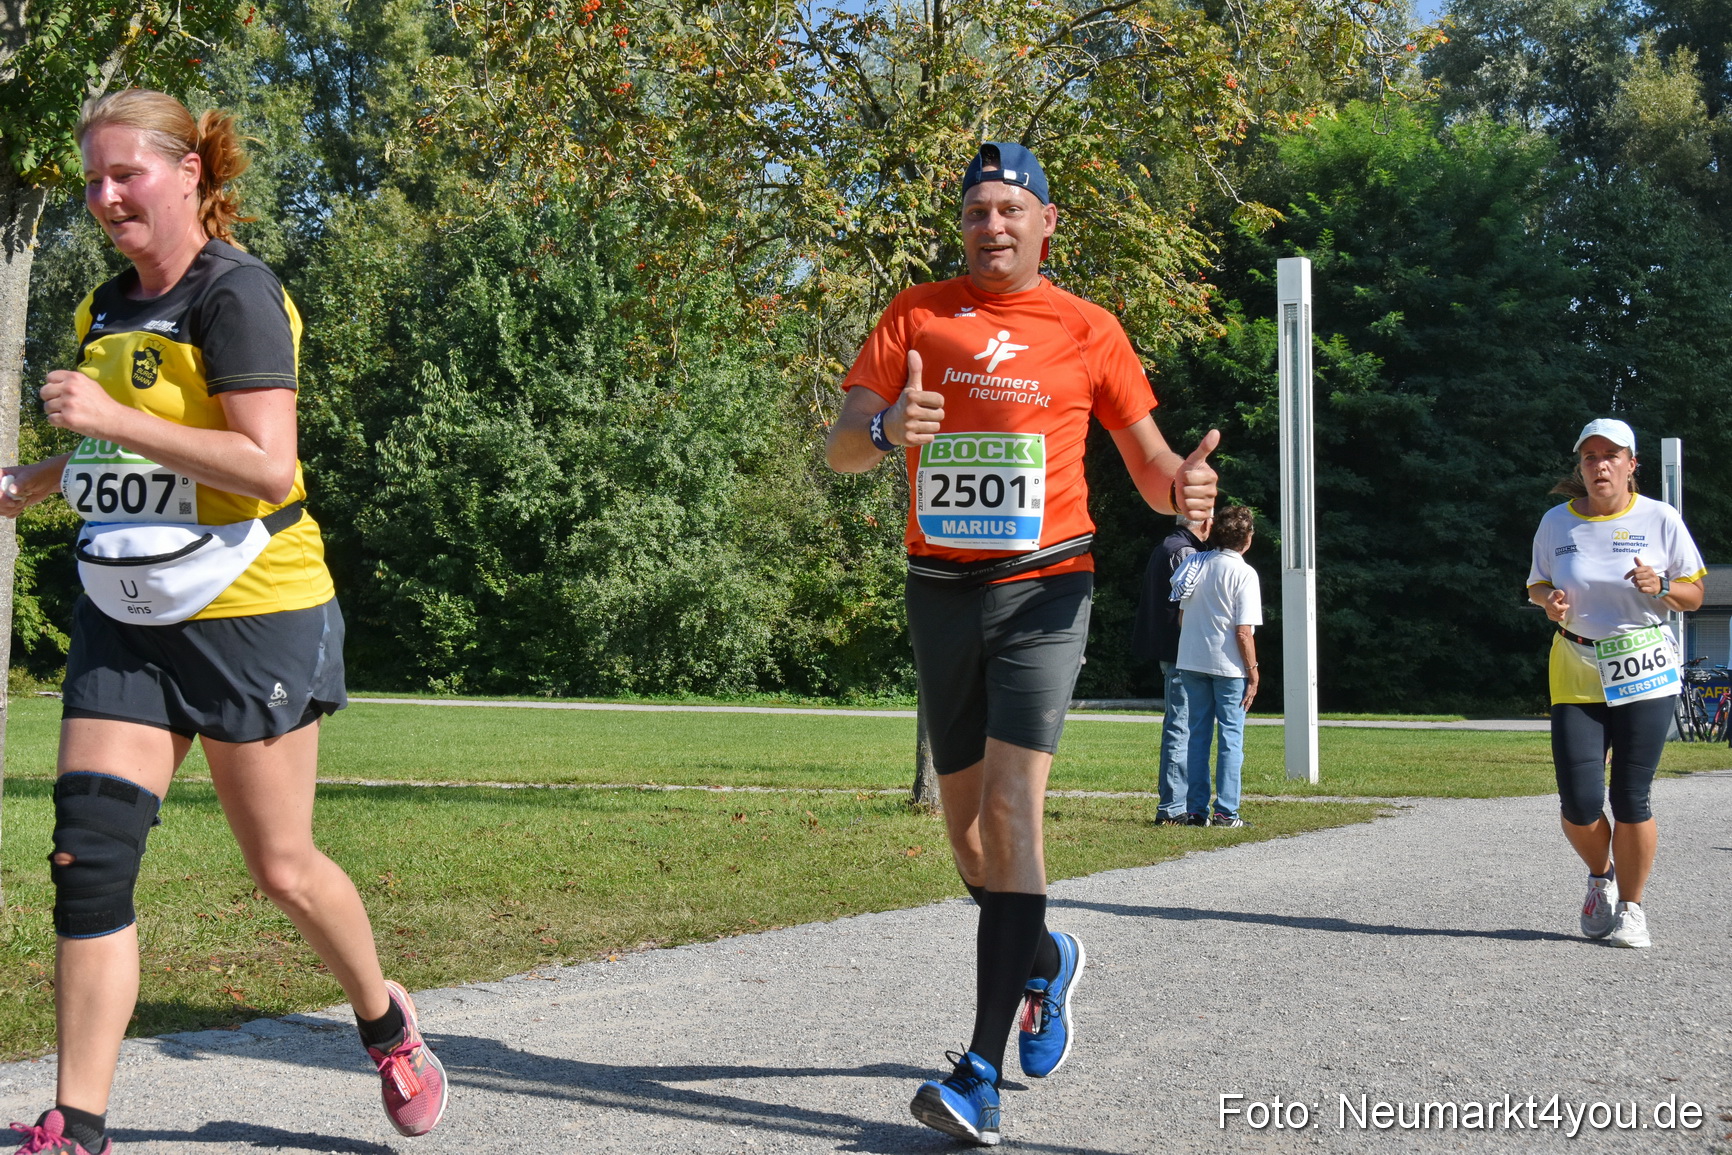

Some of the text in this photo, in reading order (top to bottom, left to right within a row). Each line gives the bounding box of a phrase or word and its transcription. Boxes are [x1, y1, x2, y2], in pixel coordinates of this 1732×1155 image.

[132, 373, 153, 386] THANN
[941, 367, 1040, 391] funrunners
[968, 387, 1052, 408] neumarkt
[929, 439, 1032, 463] BOCK
[181, 477, 189, 485] D
[930, 473, 1026, 509] 2501
[75, 472, 176, 515] 2607
[941, 520, 1017, 535] MARIUS
[1613, 531, 1629, 540] 20
[120, 579, 138, 598] U
[127, 604, 152, 614] eins
[1601, 628, 1659, 656] BOCK
[1607, 647, 1667, 682] 2046
[1618, 674, 1669, 696] KERSTIN
